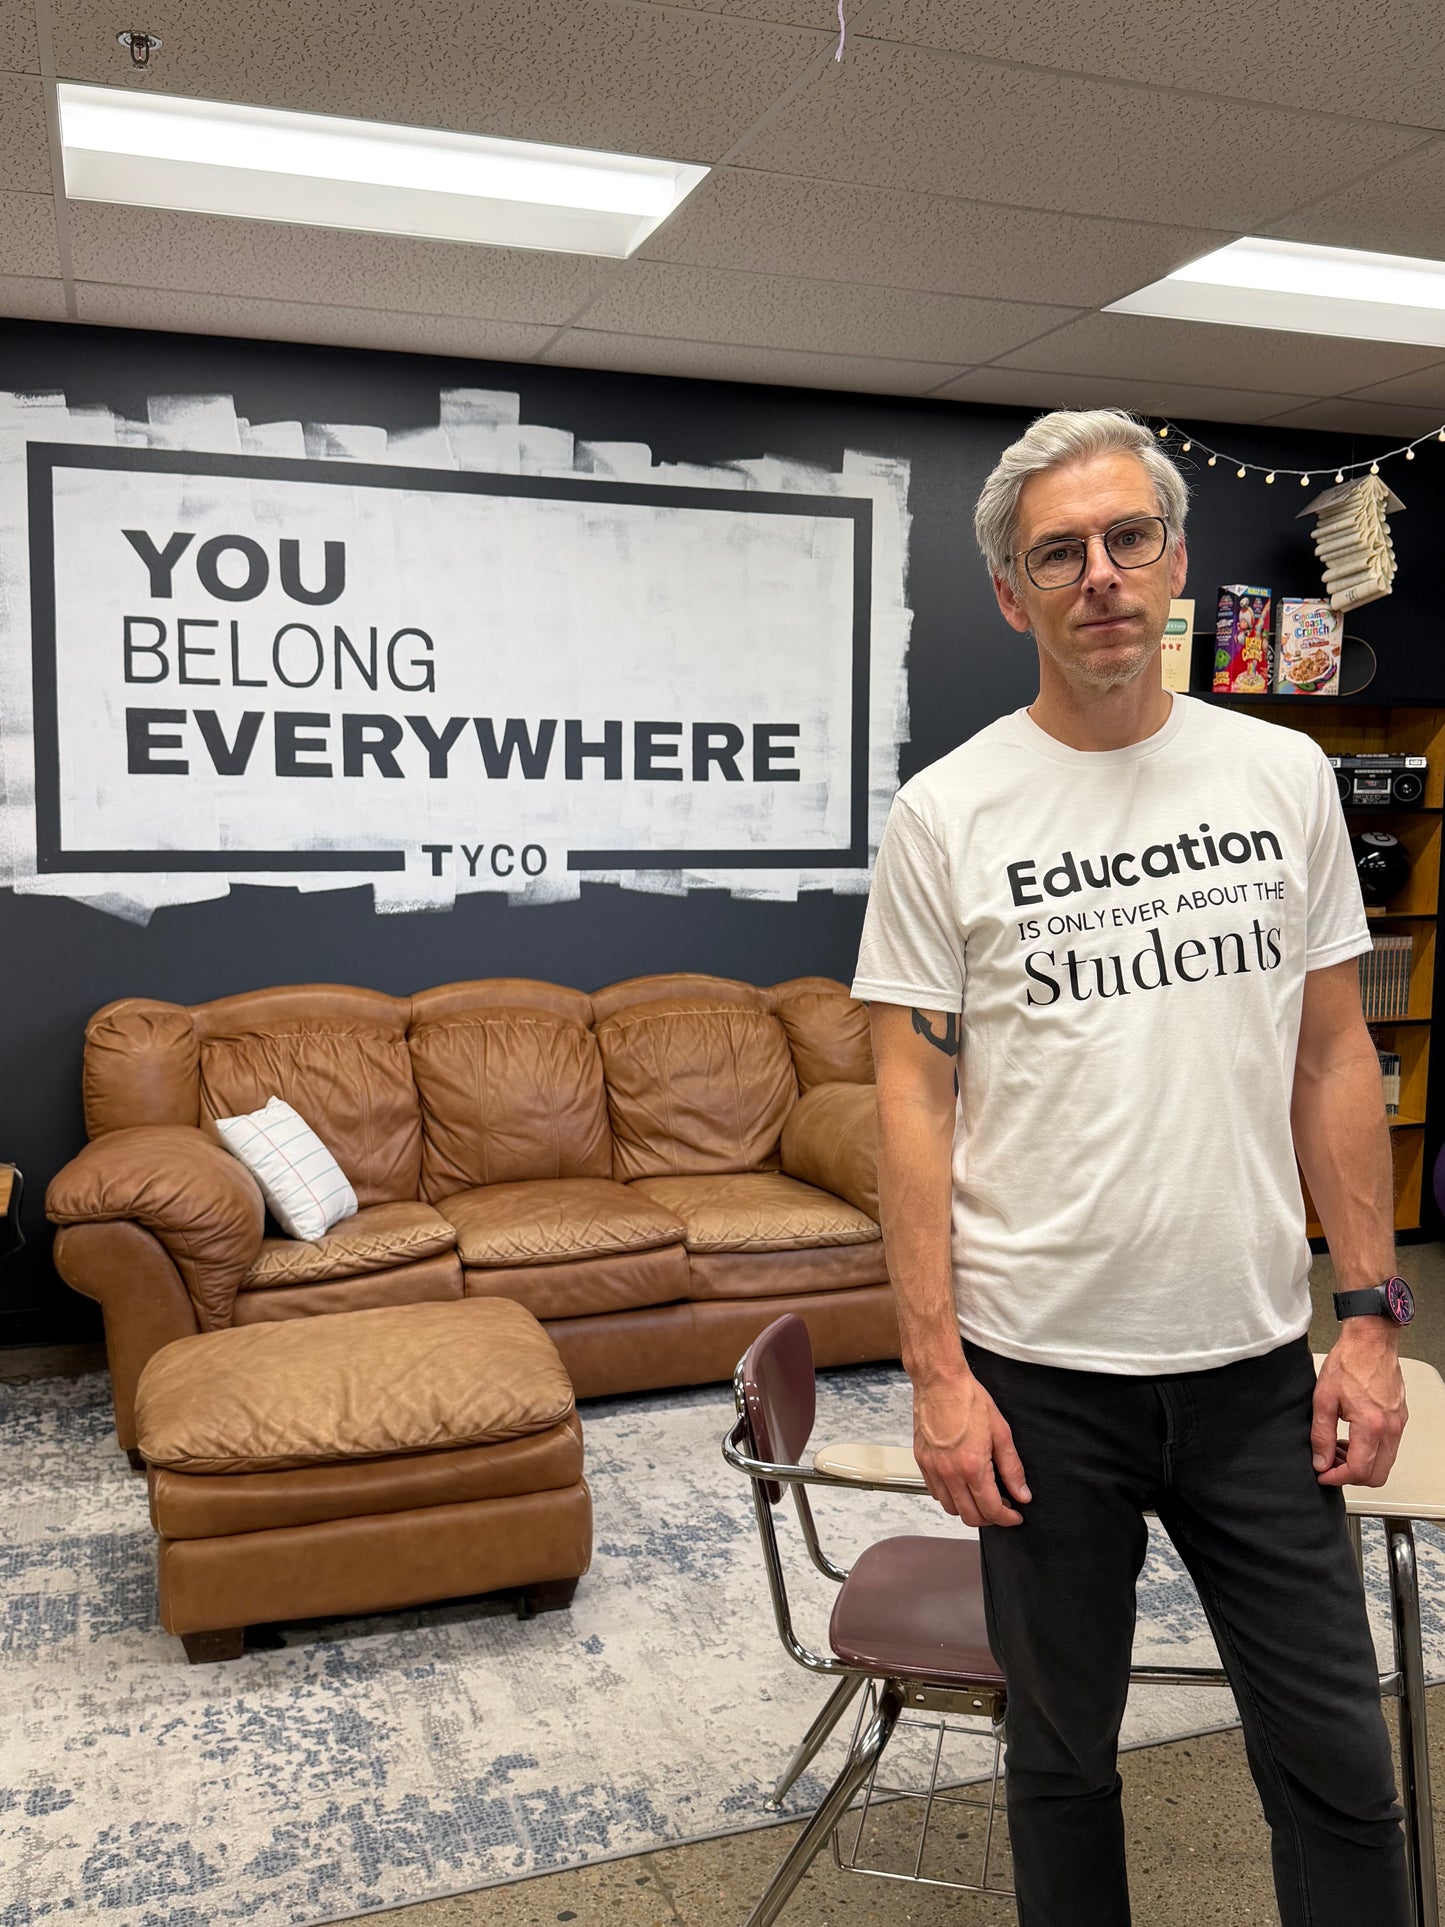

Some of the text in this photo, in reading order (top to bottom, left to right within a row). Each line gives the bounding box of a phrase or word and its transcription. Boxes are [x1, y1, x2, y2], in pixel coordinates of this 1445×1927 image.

[121, 529, 346, 605] YOU
[1293, 611, 1331, 622] Cinnamon
[1294, 624, 1330, 638] Crunch
[1299, 619, 1323, 629] Toast
[123, 616, 437, 693] BELONG
[125, 707, 802, 783] EVERYWHERE
[421, 844, 548, 879] TYCO
[1006, 822, 1284, 907] Education
[1018, 881, 1285, 941] IS ONLY EVER ABOUT THE
[1024, 918, 1282, 1007] Students
